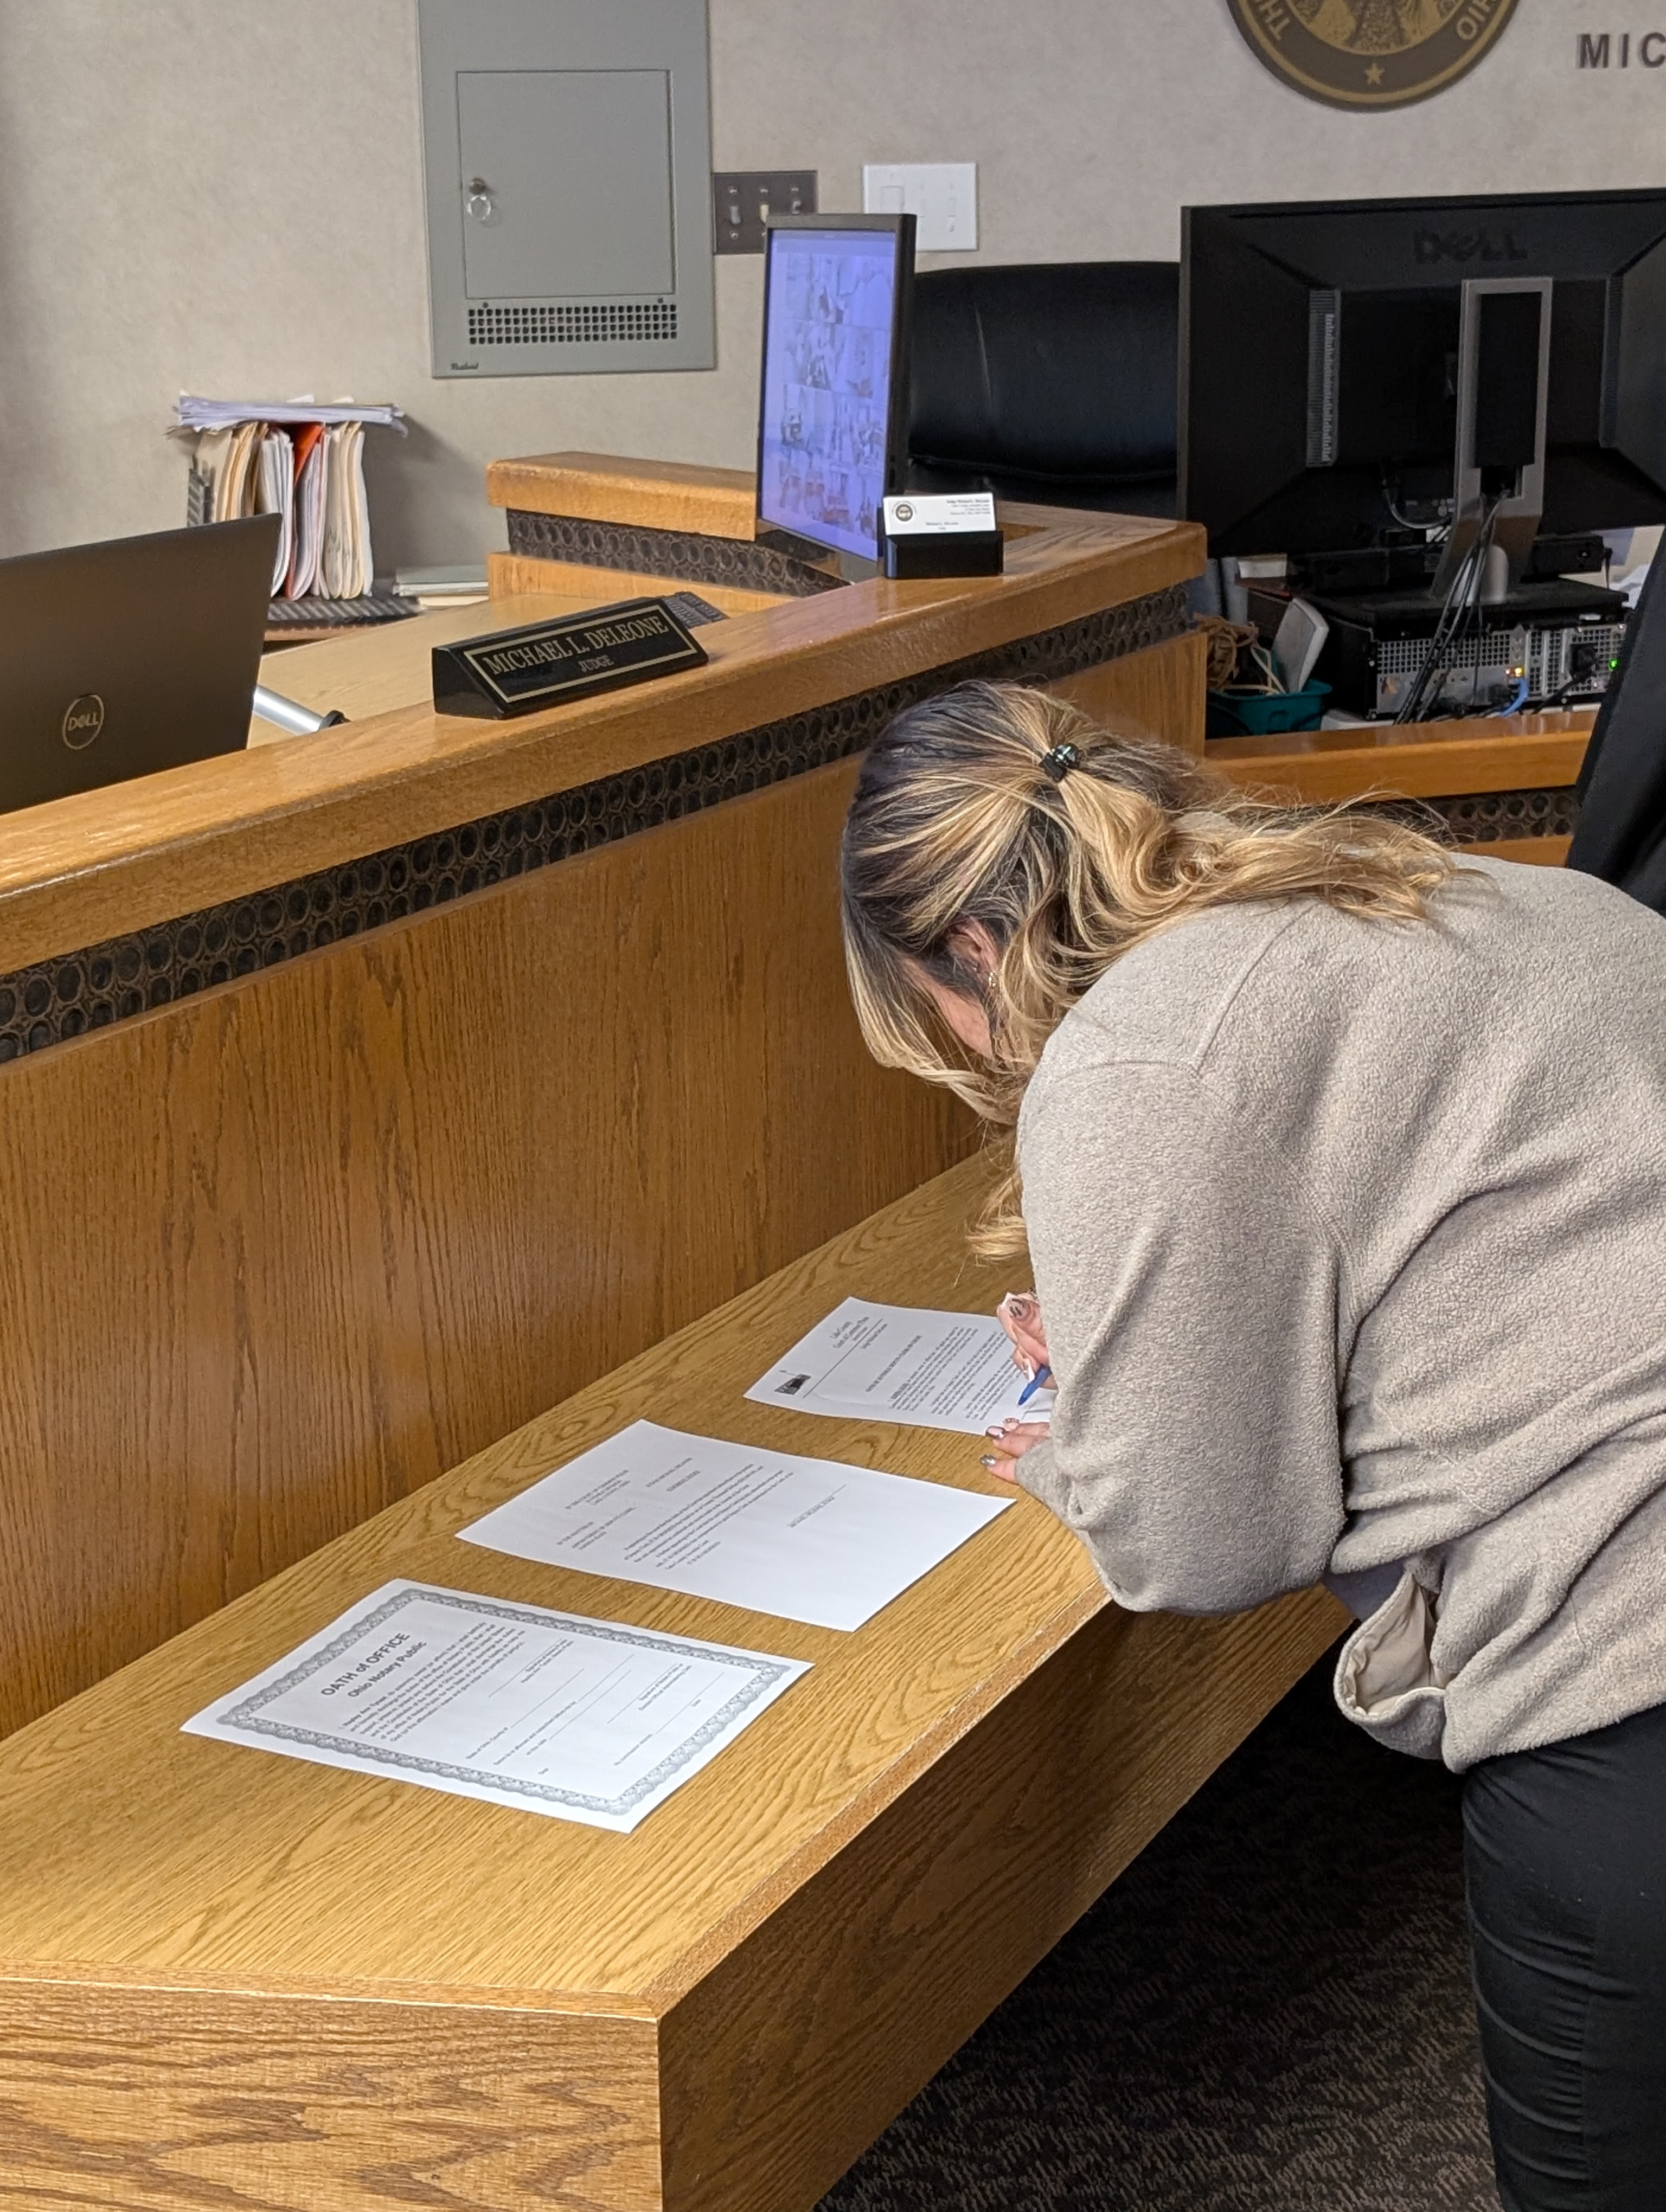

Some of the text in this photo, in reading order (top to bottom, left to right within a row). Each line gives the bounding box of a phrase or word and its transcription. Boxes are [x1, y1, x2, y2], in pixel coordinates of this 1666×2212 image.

[1578, 33, 1666, 69] MIC
[1413, 232, 1528, 263] DELL
[483, 636, 573, 675] MICHAEL
[591, 615, 669, 650] DELEONE
[578, 654, 614, 672] JUDGE
[68, 710, 99, 731] DELL
[321, 1633, 411, 1695] OATH of OFFICE
[347, 1642, 427, 1697] Ohio Notary Public
